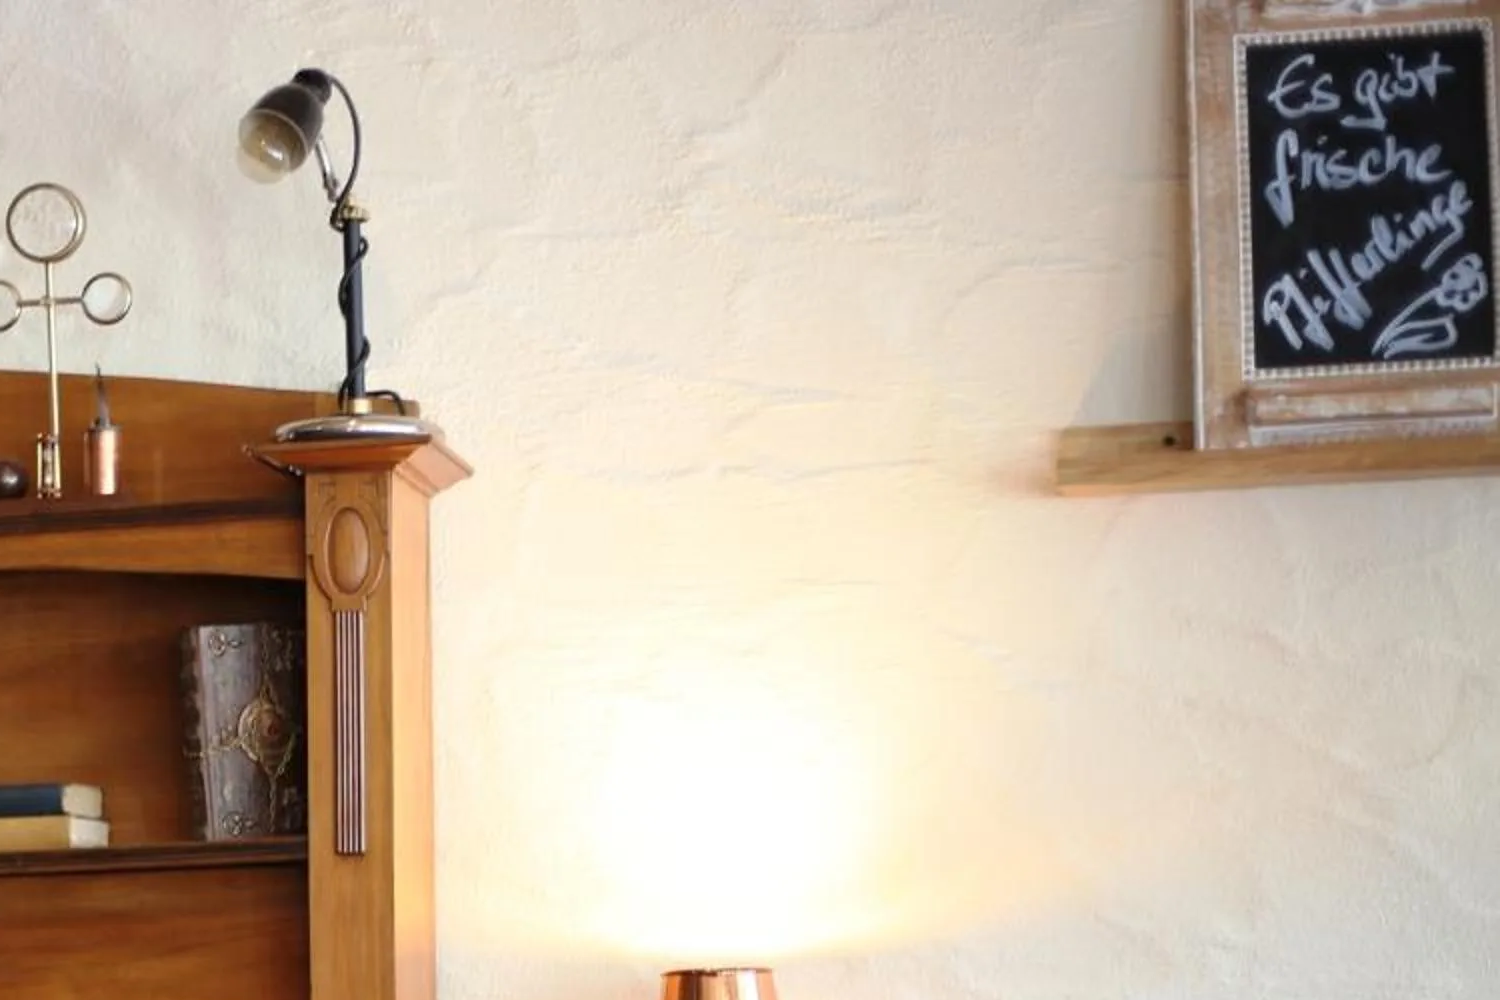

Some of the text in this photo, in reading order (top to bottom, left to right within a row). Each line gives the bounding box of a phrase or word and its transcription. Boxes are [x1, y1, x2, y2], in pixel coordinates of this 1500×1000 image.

[1268, 51, 1454, 131] Es gibt
[1264, 129, 1452, 228] frische
[1263, 180, 1472, 351] Pfifferlinge
